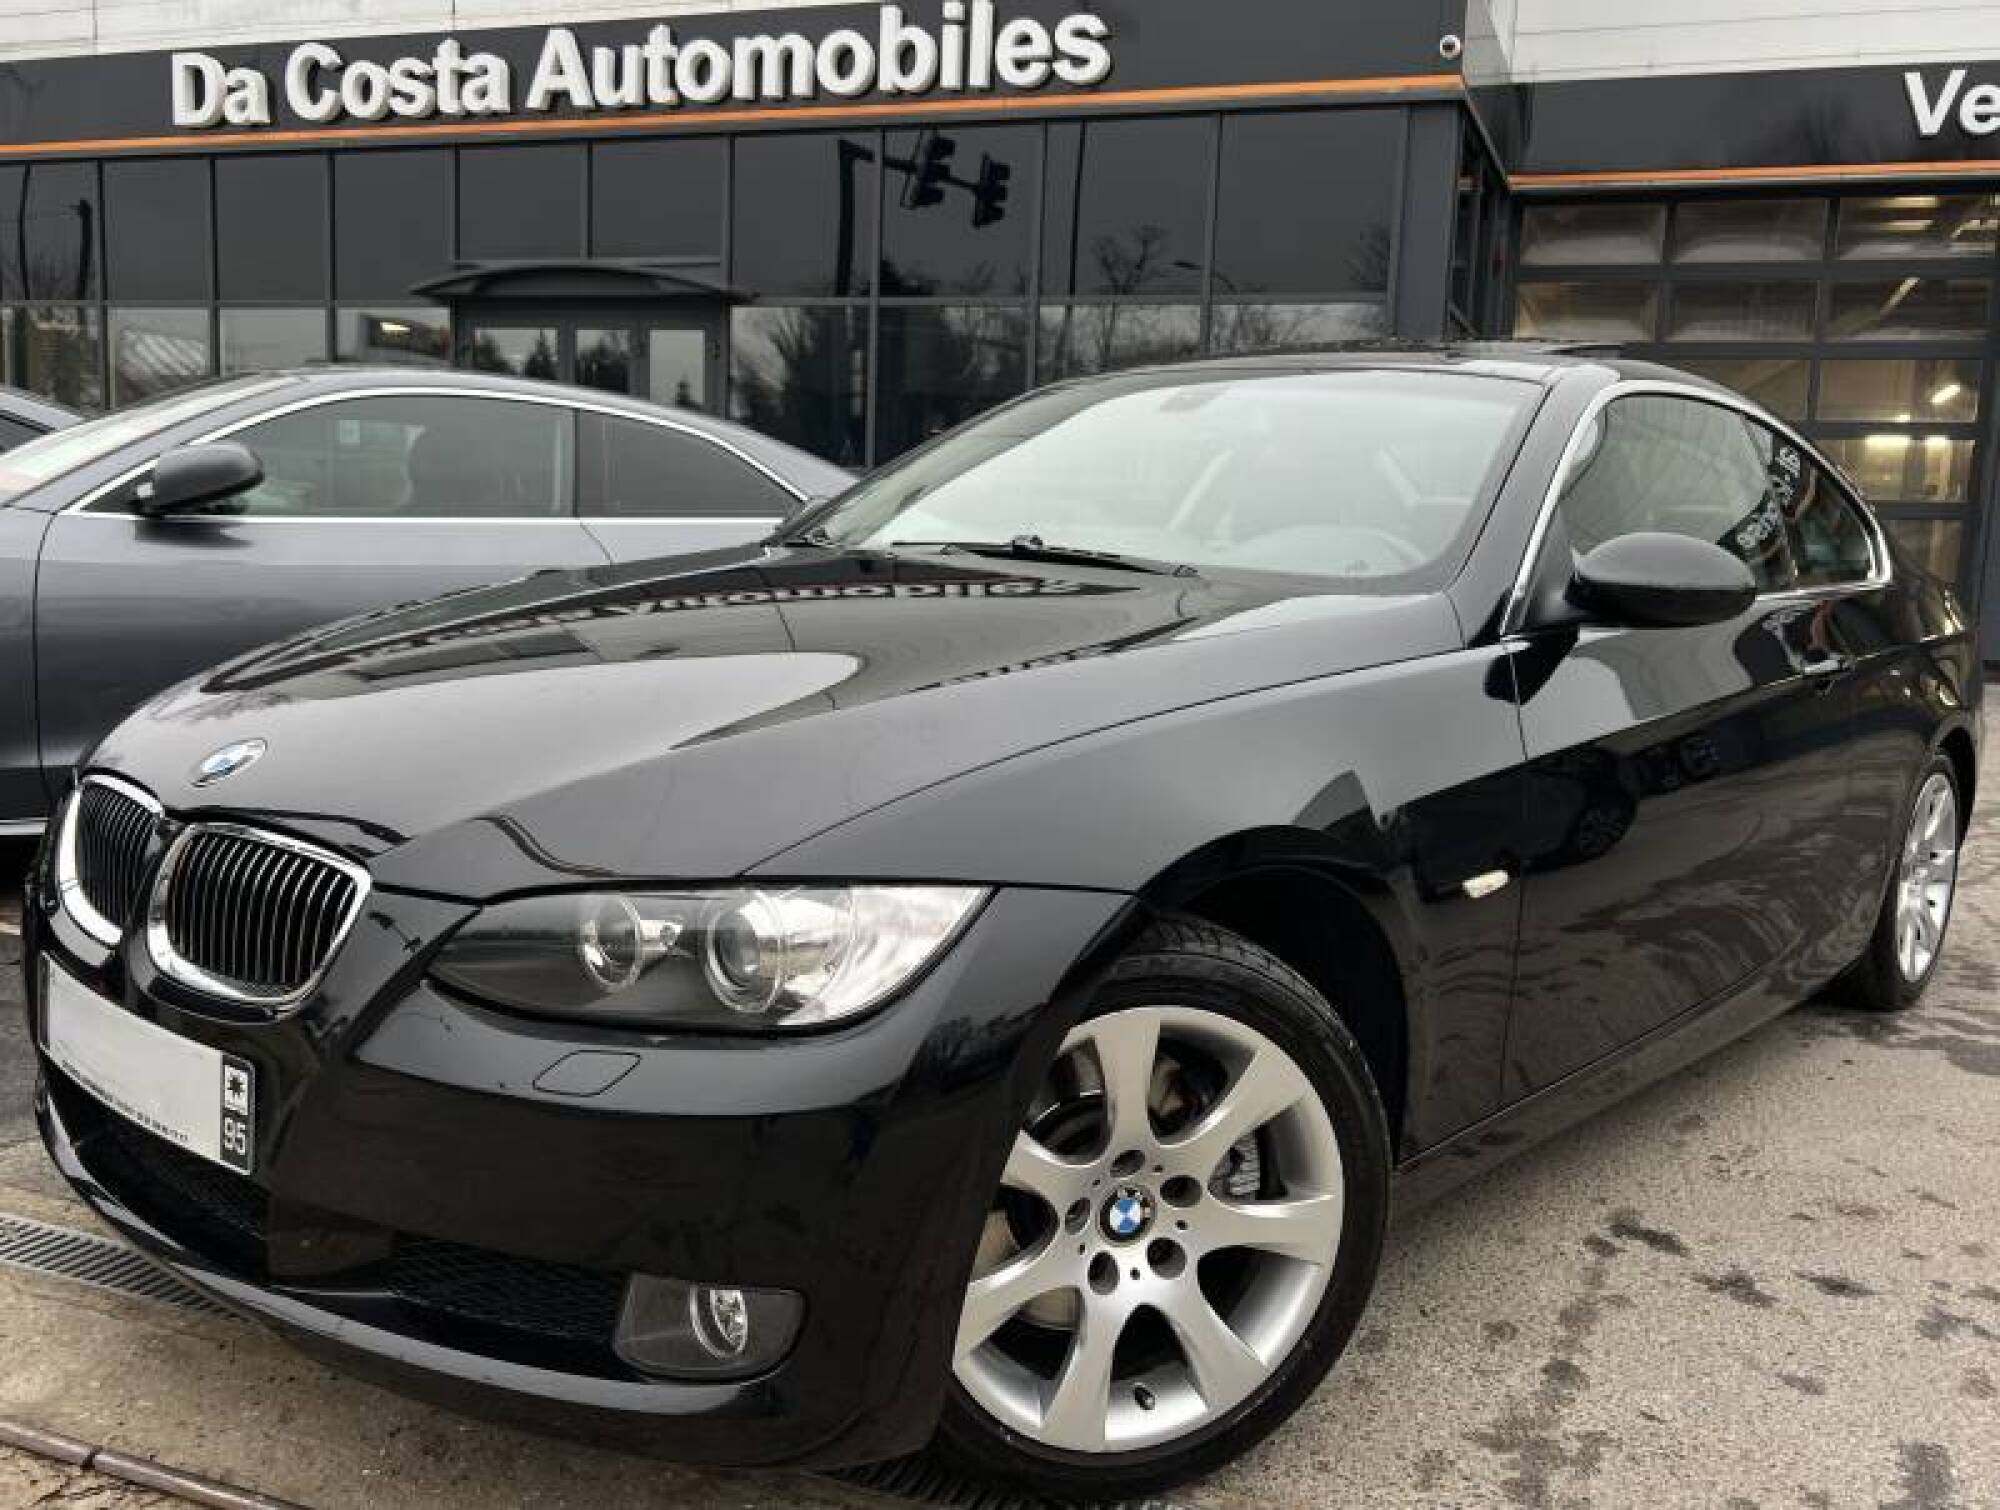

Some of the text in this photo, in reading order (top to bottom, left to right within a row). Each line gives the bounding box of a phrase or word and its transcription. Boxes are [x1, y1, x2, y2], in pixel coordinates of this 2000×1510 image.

[172, 0, 1112, 126] Da Costa Automobiles
[1904, 69, 2000, 136] Ve
